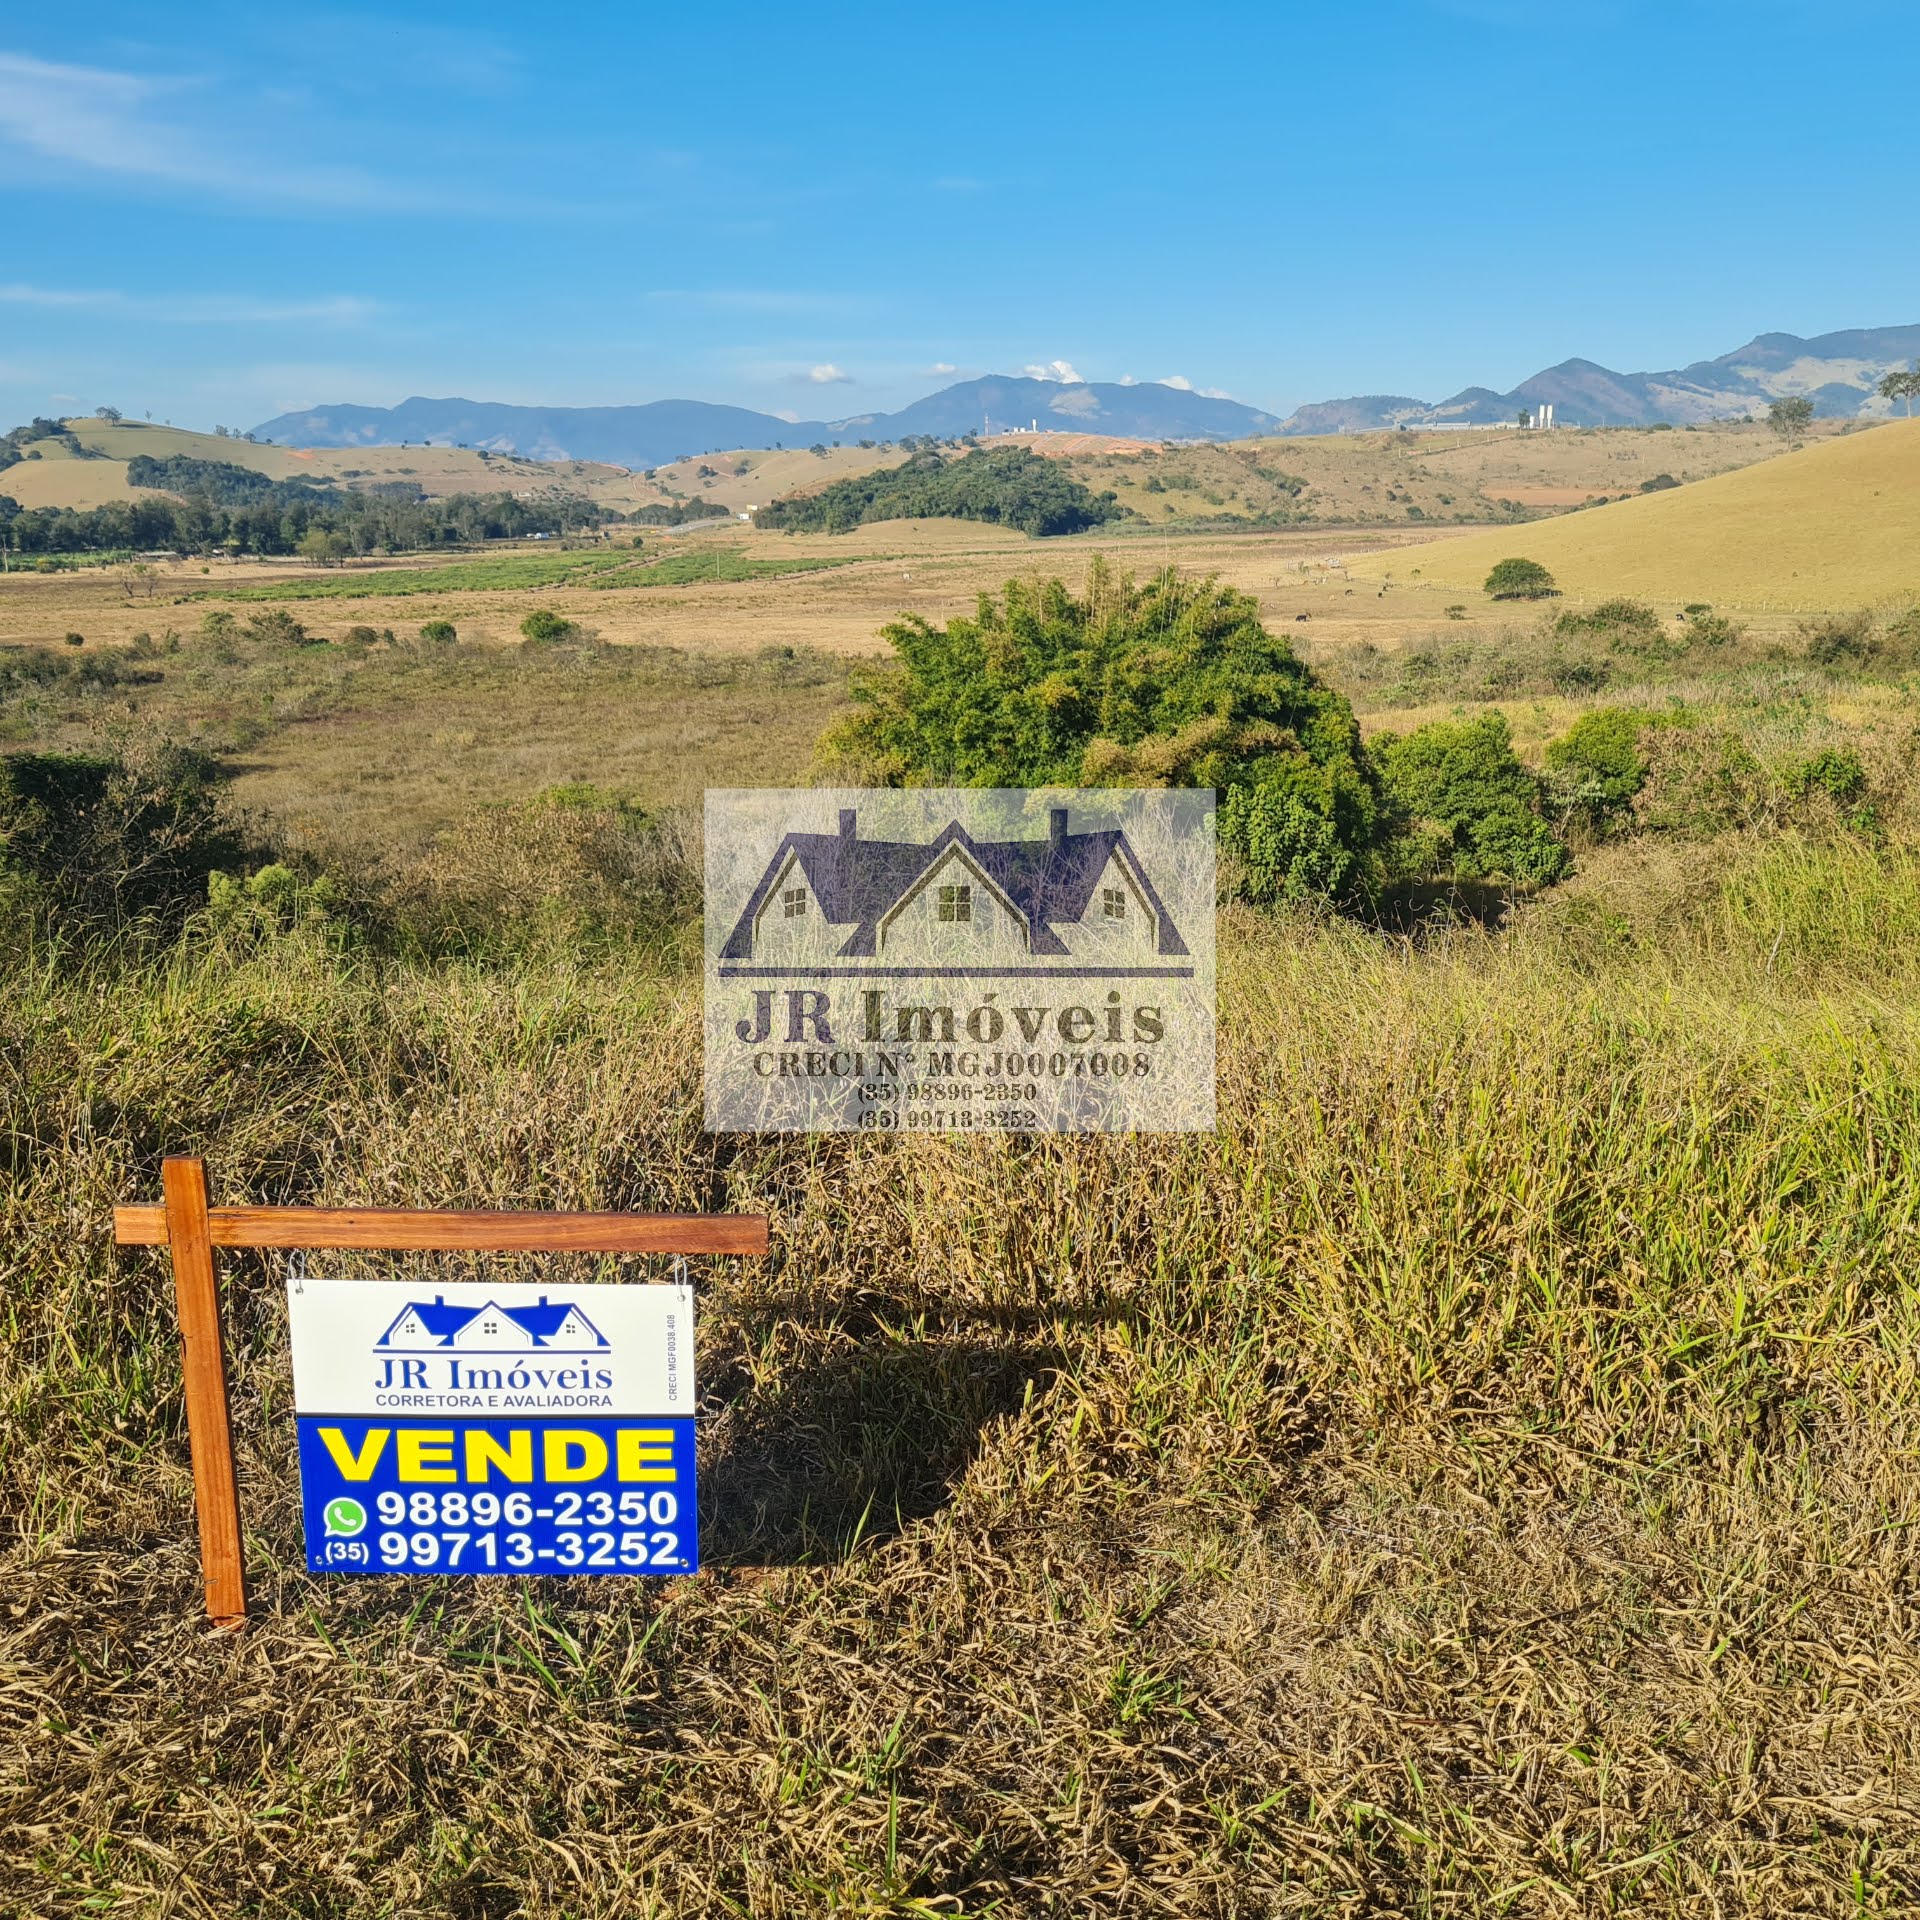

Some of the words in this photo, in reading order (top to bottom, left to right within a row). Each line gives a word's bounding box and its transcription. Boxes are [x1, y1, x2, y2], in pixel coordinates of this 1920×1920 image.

[666, 1314, 677, 1371] MGF0038.408
[374, 1358, 432, 1390] JR
[446, 1359, 613, 1391] Imóveis
[668, 1373, 678, 1401] CRECI
[375, 1393, 484, 1408] CORRETORA
[488, 1394, 499, 1408] E
[503, 1393, 613, 1408] AVALIADORA
[317, 1428, 677, 1483] VENDE
[378, 1491, 678, 1526] 98896-2350
[325, 1541, 370, 1566] (35)
[379, 1532, 679, 1566] 99713-3252
